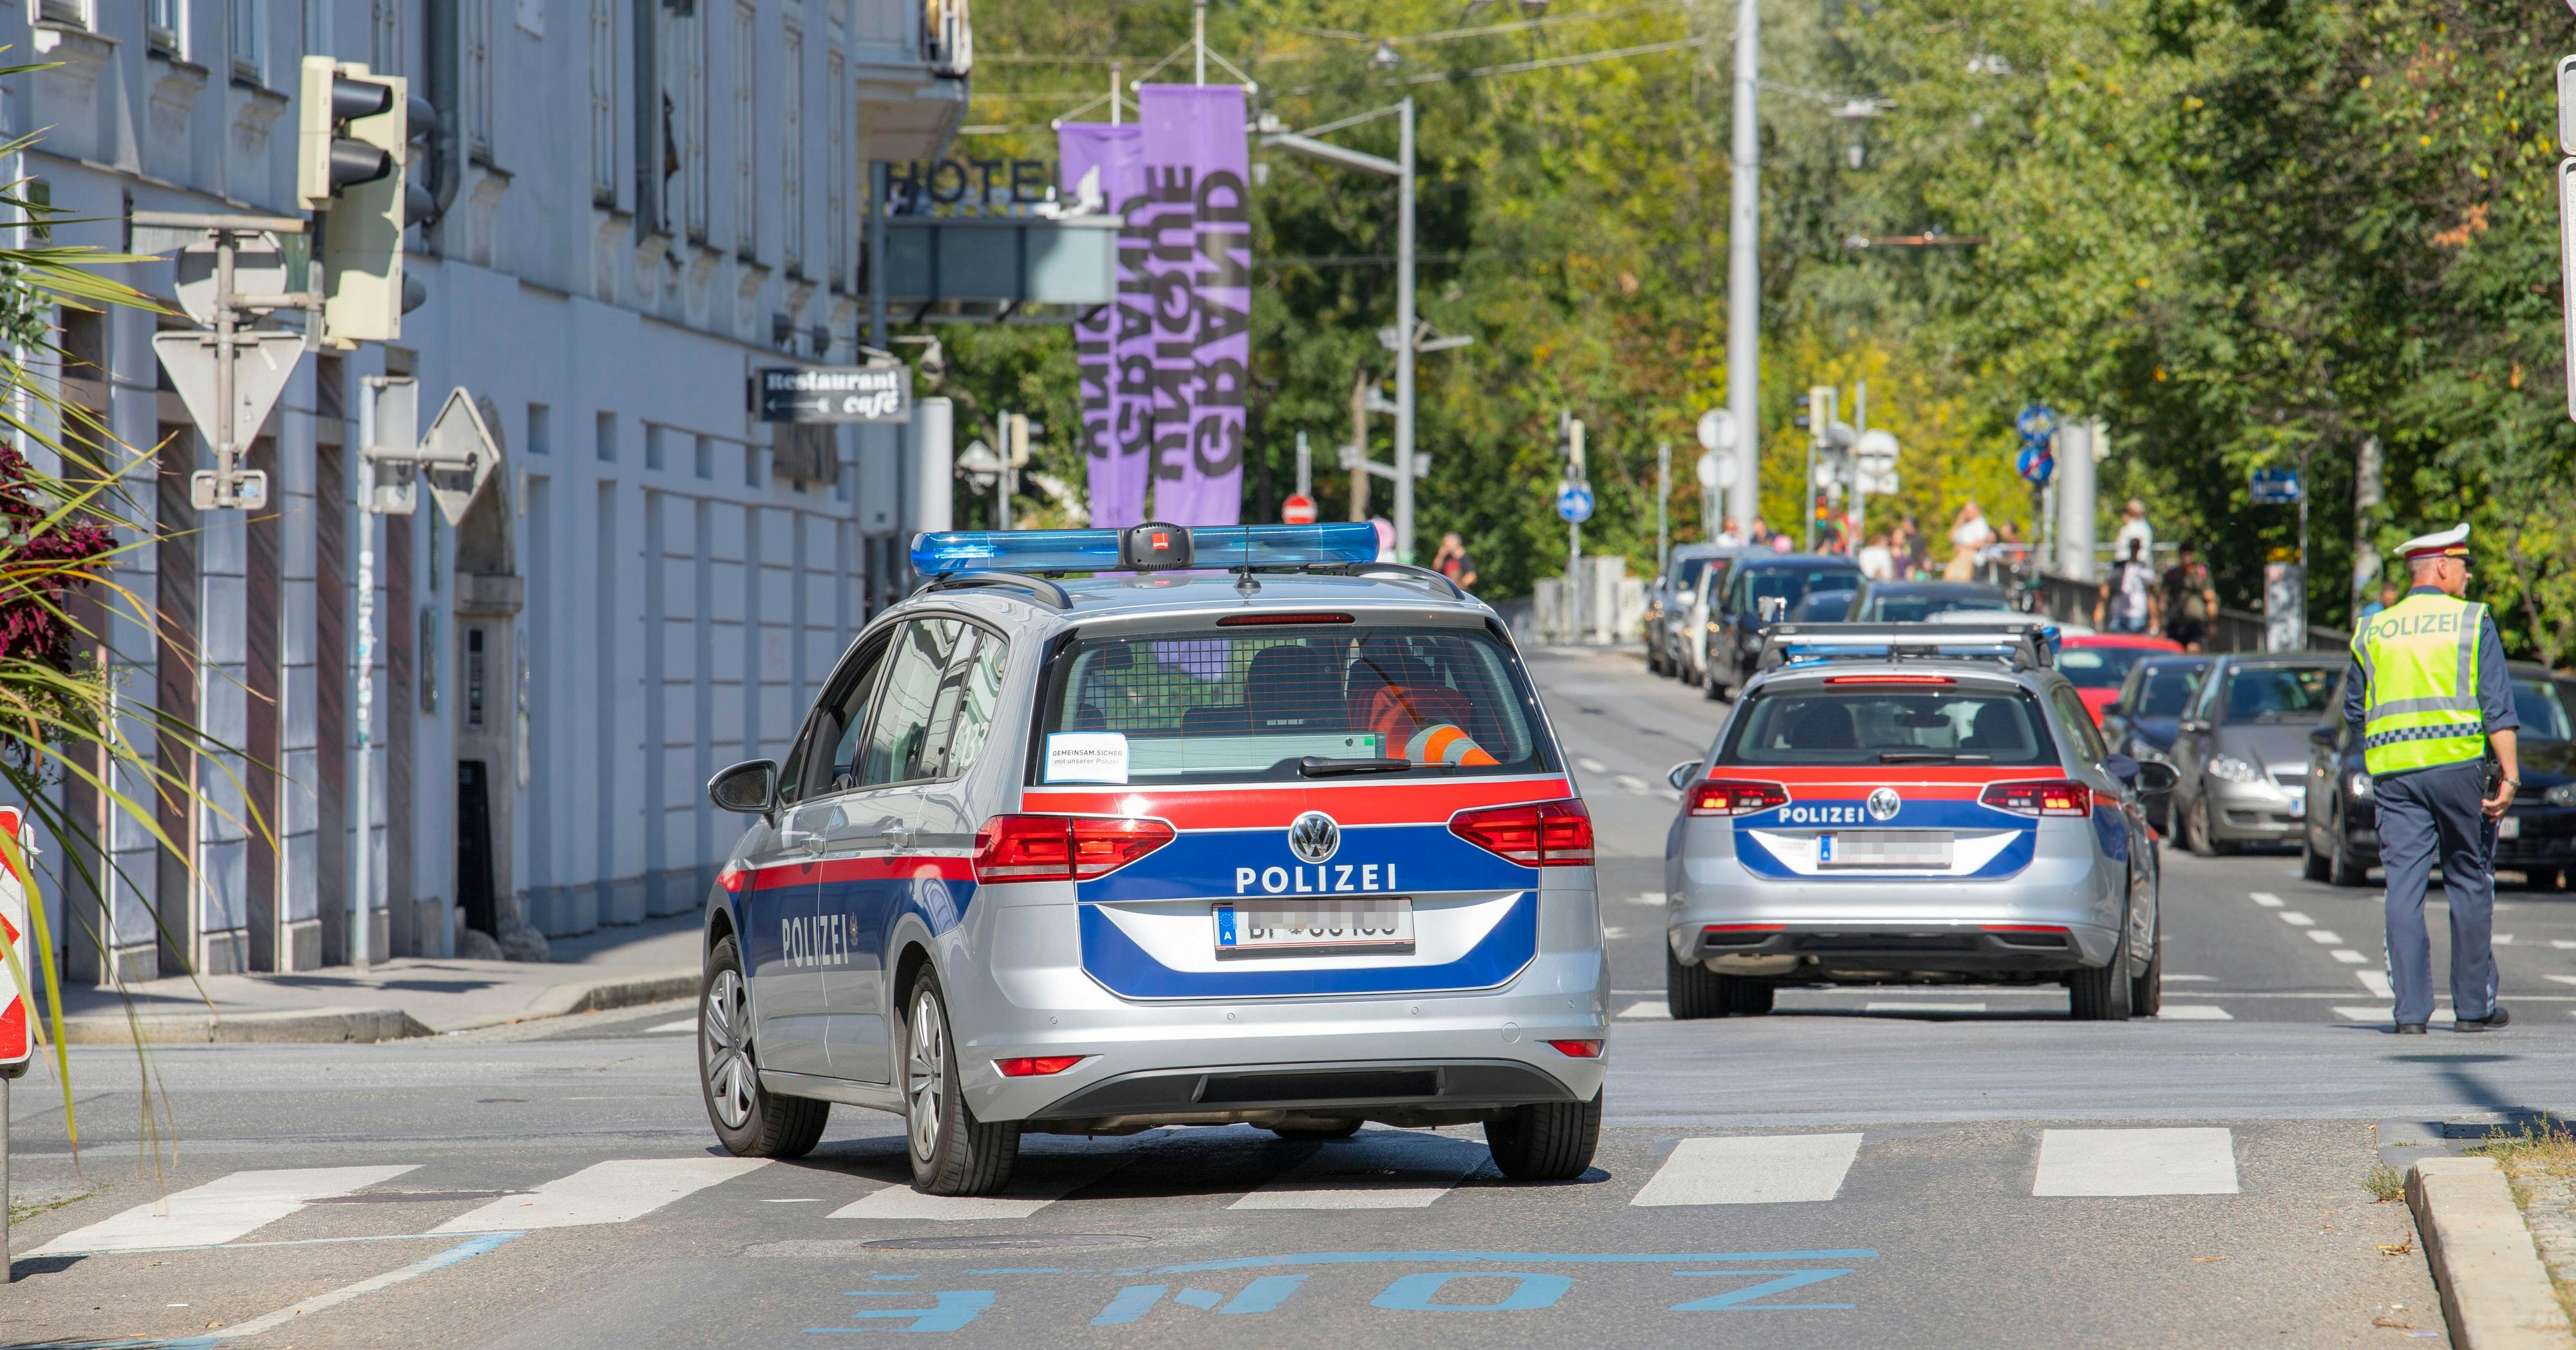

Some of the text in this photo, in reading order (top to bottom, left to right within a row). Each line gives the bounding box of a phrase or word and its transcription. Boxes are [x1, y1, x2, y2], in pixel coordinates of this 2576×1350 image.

[885, 160, 1083, 205] HOTEL
[767, 371, 898, 391] Restaurant
[842, 389, 899, 419] café
[2367, 612, 2459, 644] POLIZEI
[1779, 807, 1865, 823] POLIZEI
[1236, 863, 1396, 894] POLIZEI
[782, 914, 848, 968] POLIZEI
[1224, 931, 1233, 940] A
